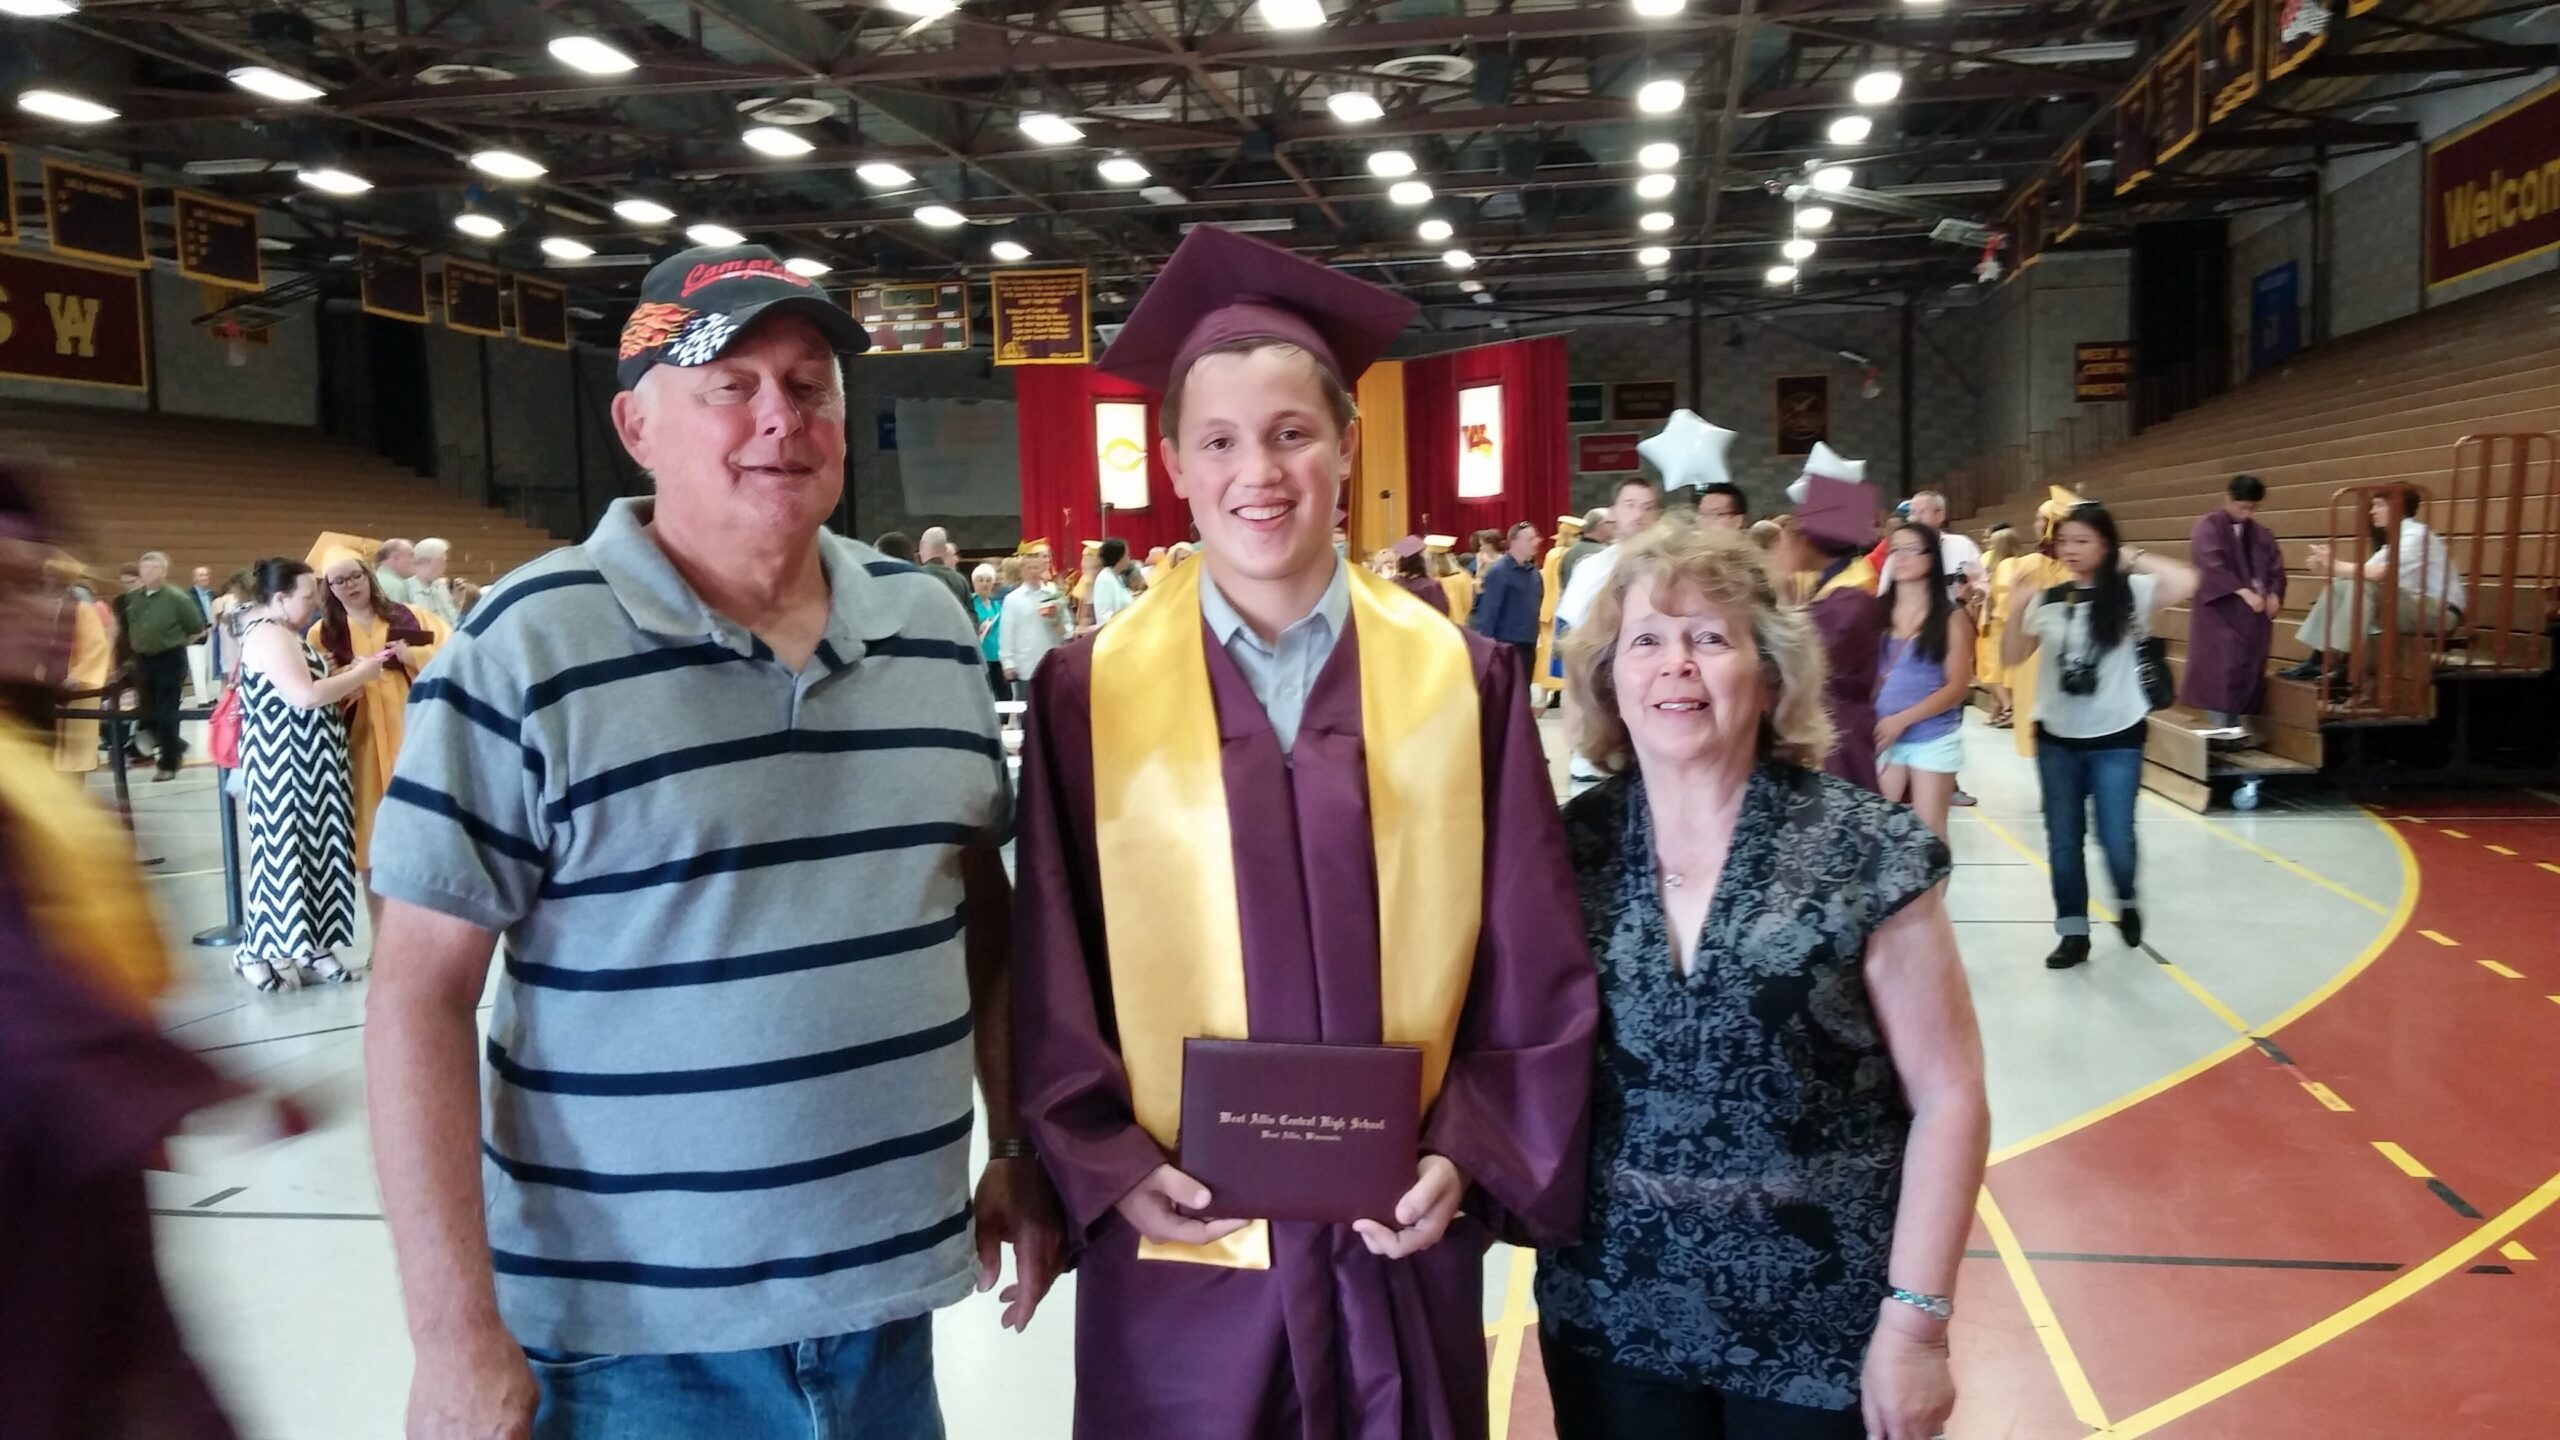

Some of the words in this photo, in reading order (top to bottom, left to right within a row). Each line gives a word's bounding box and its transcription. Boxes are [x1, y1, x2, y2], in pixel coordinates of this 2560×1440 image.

[1219, 1111, 1246, 1125] West
[1249, 1112, 1276, 1126] Allis
[1278, 1114, 1316, 1127] Central
[1319, 1115, 1346, 1131] High
[1350, 1117, 1385, 1130] School
